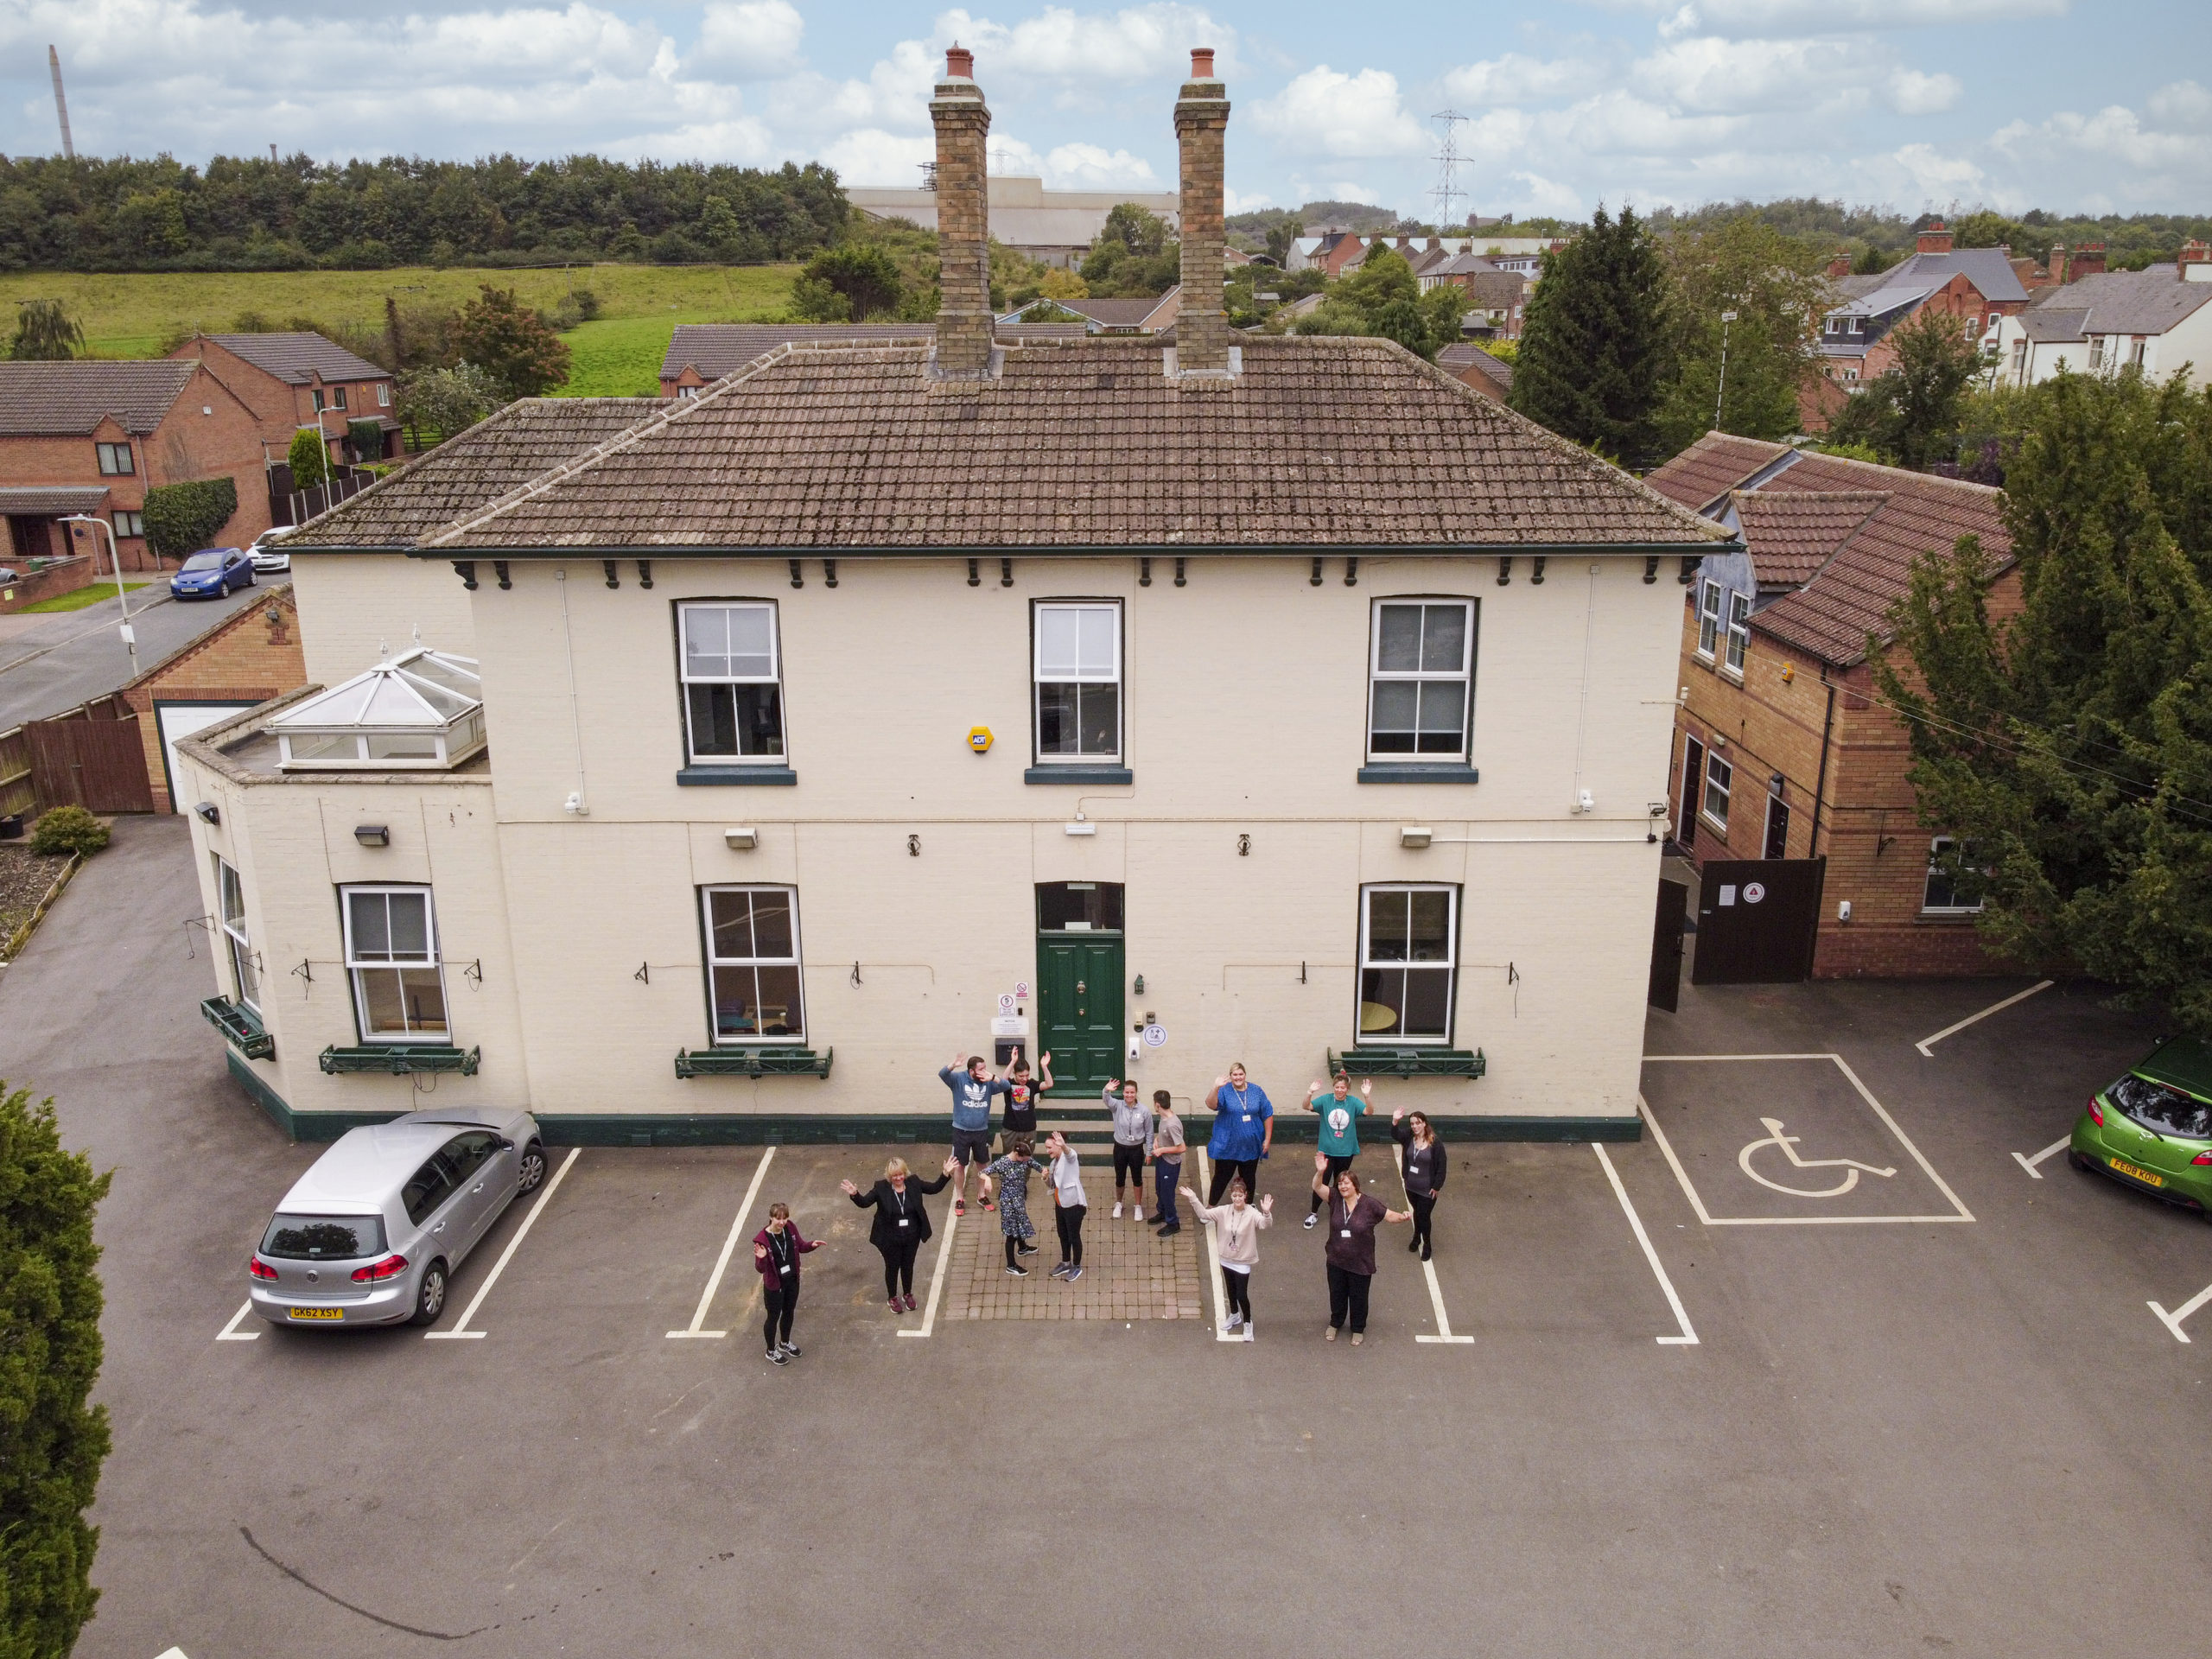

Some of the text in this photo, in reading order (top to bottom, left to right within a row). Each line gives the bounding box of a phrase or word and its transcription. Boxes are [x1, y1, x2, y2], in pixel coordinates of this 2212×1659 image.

[2113, 1160, 2138, 1175] FE08
[294, 1307, 339, 1317] GK62 XSY
